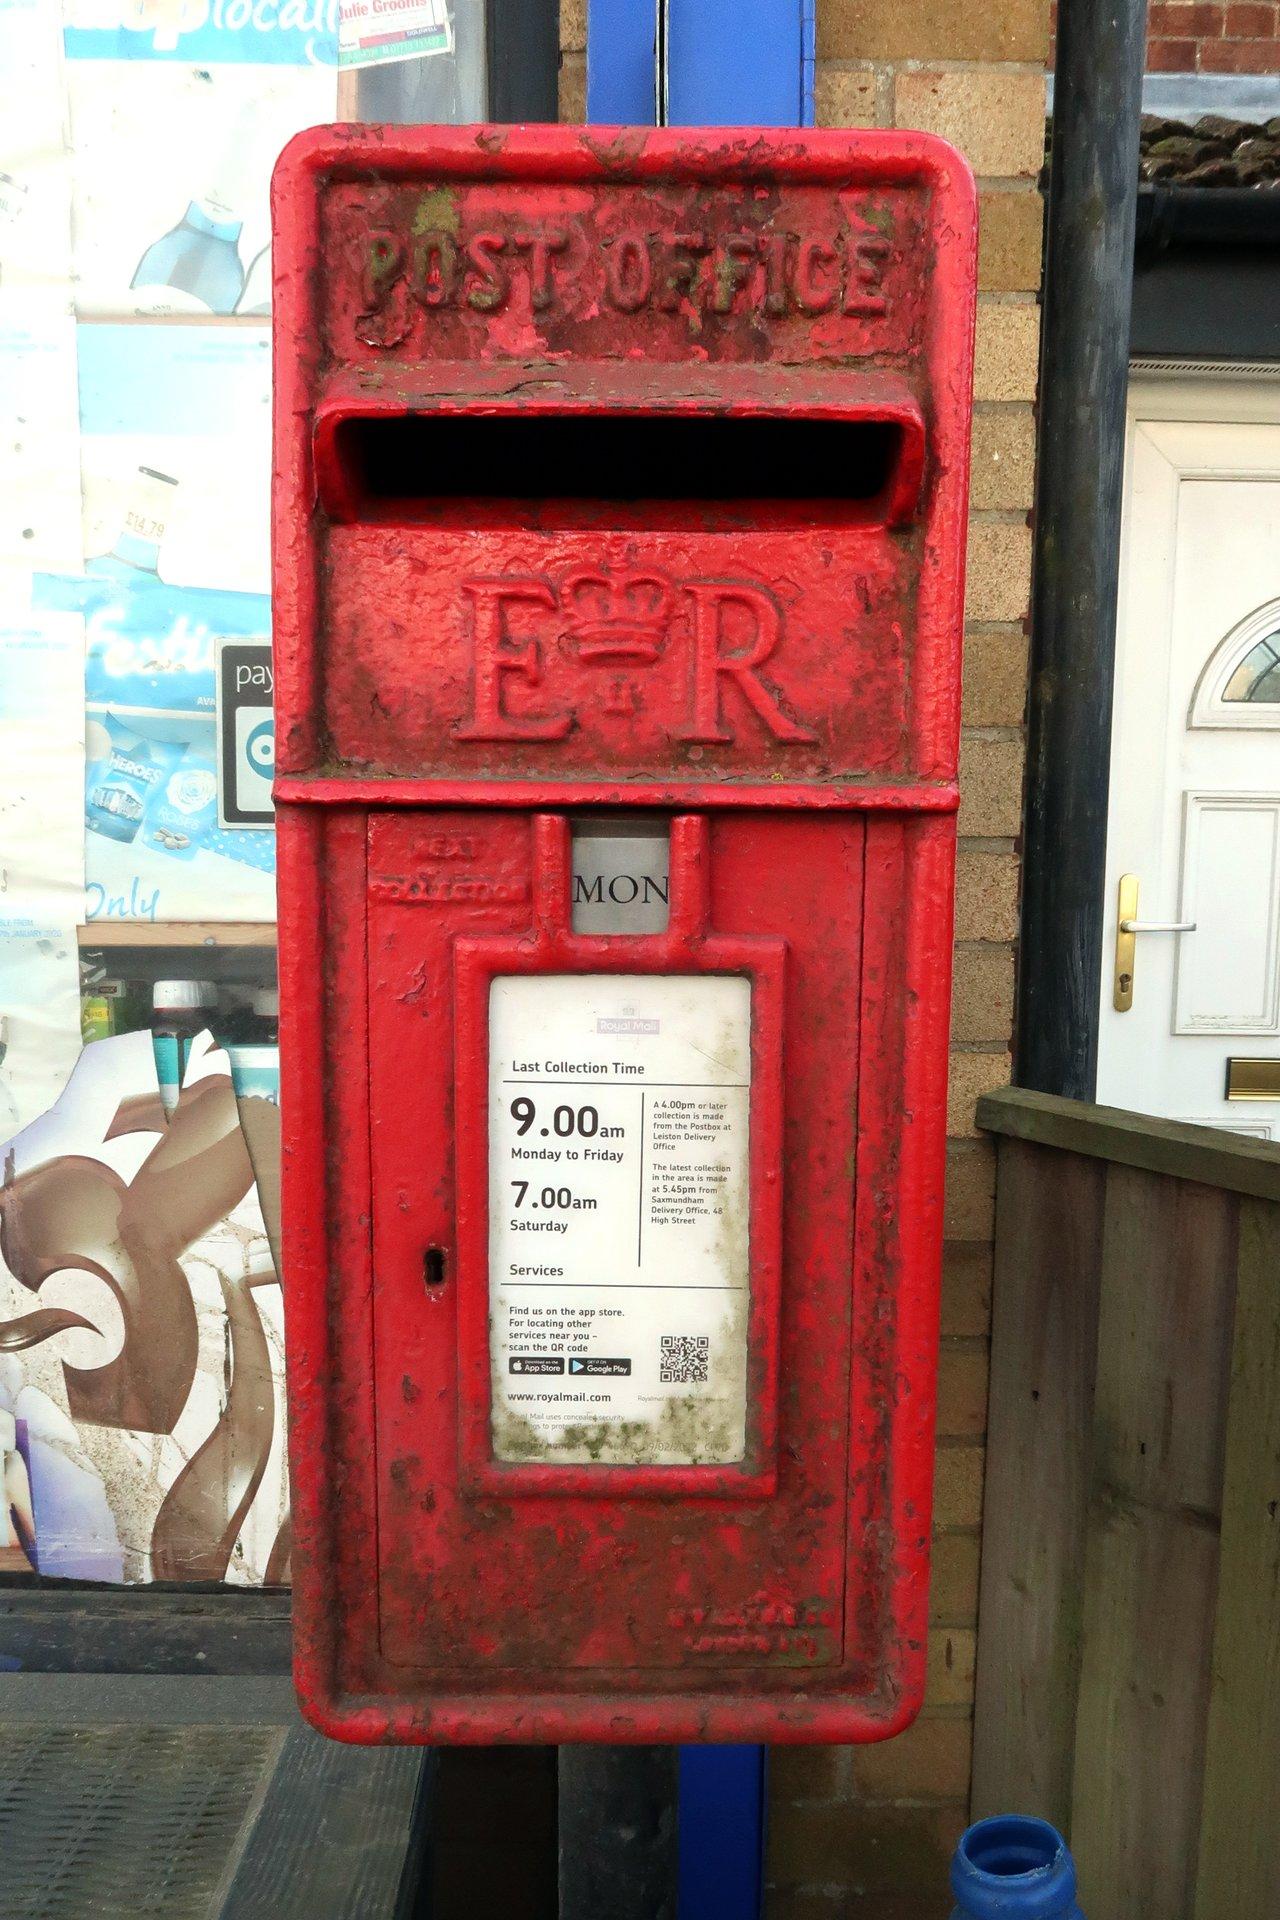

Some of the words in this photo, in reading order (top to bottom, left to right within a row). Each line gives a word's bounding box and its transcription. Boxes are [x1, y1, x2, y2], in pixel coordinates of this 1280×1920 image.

[365, 229, 570, 312] POST
[600, 230, 893, 320] OFFICE
[236, 664, 274, 693] pay
[108, 750, 164, 785] HEROES
[159, 806, 201, 831] ROSES
[572, 874, 670, 904] MON
[85, 876, 160, 923] Only
[600, 1020, 631, 1032] Royal
[632, 1021, 657, 1031] Mail
[512, 1060, 540, 1072] Last
[545, 1061, 608, 1074] Collection
[612, 1062, 645, 1074] Time
[661, 1100, 695, 1110] 4.00pm
[709, 1102, 728, 1110] later
[510, 1097, 625, 1138] 9.00am
[653, 1112, 690, 1120] collection
[693, 1112, 699, 1120] is
[653, 1122, 672, 1130] from
[675, 1122, 688, 1130] the
[690, 1122, 721, 1131] Postbox
[684, 1133, 716, 1142] Delivery
[653, 1143, 676, 1151] Office
[511, 1147, 561, 1162] Monday
[566, 1150, 579, 1160] to
[584, 1149, 624, 1163] Friday
[653, 1163, 667, 1171] The
[670, 1163, 692, 1171] latest
[697, 1174, 704, 1182] is
[706, 1175, 728, 1183] made
[662, 1184, 696, 1195] 5.45pm
[698, 1186, 718, 1194] from
[510, 1181, 598, 1210] 7.00am
[651, 1195, 704, 1204] Saxmundham
[651, 1206, 683, 1215] Delivery
[685, 1206, 711, 1215] Office,
[651, 1216, 669, 1225] High
[671, 1217, 696, 1225] Street
[510, 1219, 568, 1234] Saturday
[509, 1264, 564, 1276] Services
[510, 1306, 529, 1315] Find
[561, 1307, 576, 1316] the
[578, 1309, 596, 1318] app
[598, 1308, 625, 1317] store.
[510, 1318, 524, 1327] For
[527, 1319, 564, 1329] locating
[567, 1320, 592, 1328] other
[509, 1331, 546, 1340] services
[550, 1333, 570, 1341] near
[573, 1334, 590, 1342] you
[509, 1343, 530, 1351] scan
[533, 1343, 548, 1351] the
[551, 1343, 564, 1353] QR
[567, 1343, 589, 1352] code
[541, 1364, 561, 1372] Store
[587, 1365, 612, 1374] Google
[613, 1366, 628, 1374] Play
[508, 1392, 612, 1402] www.royalmail.com
[530, 1413, 544, 1421] Mail
